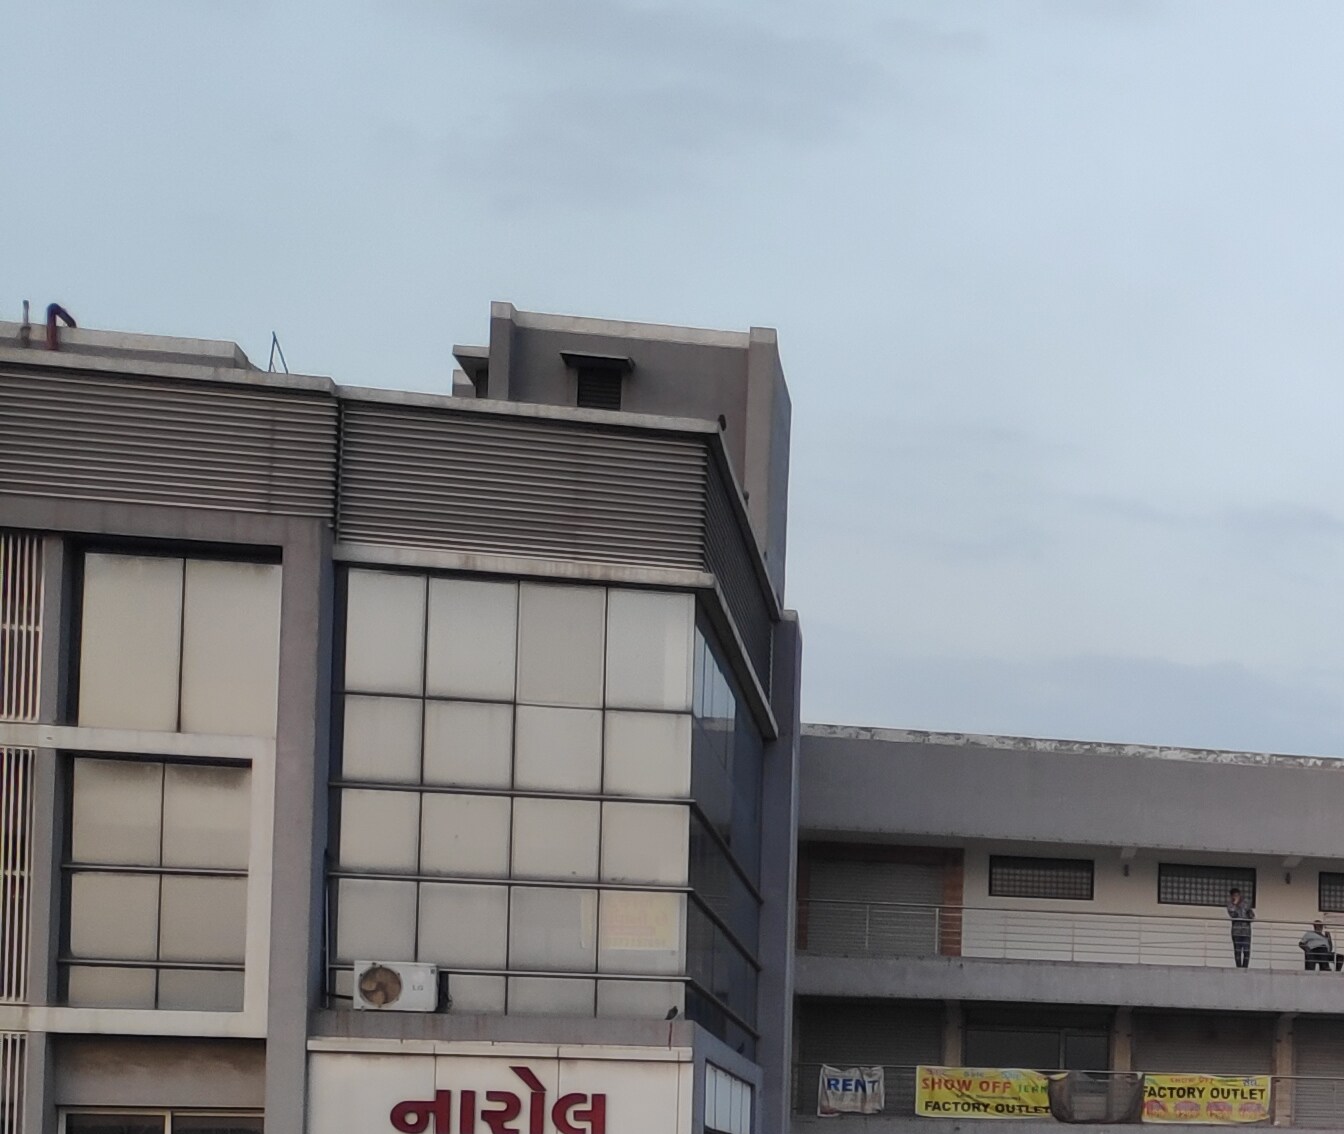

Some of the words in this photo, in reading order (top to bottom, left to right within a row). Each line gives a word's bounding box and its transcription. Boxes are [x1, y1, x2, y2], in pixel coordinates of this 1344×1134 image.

[827, 1077, 879, 1093] RENT
[922, 1078, 972, 1091] SHOW
[979, 1080, 1011, 1093] OFF
[1143, 1086, 1205, 1099] FACTORY
[1210, 1087, 1266, 1100] OUTLET
[925, 1101, 989, 1112] FACTORY
[995, 1103, 1050, 1113] OUTLET
